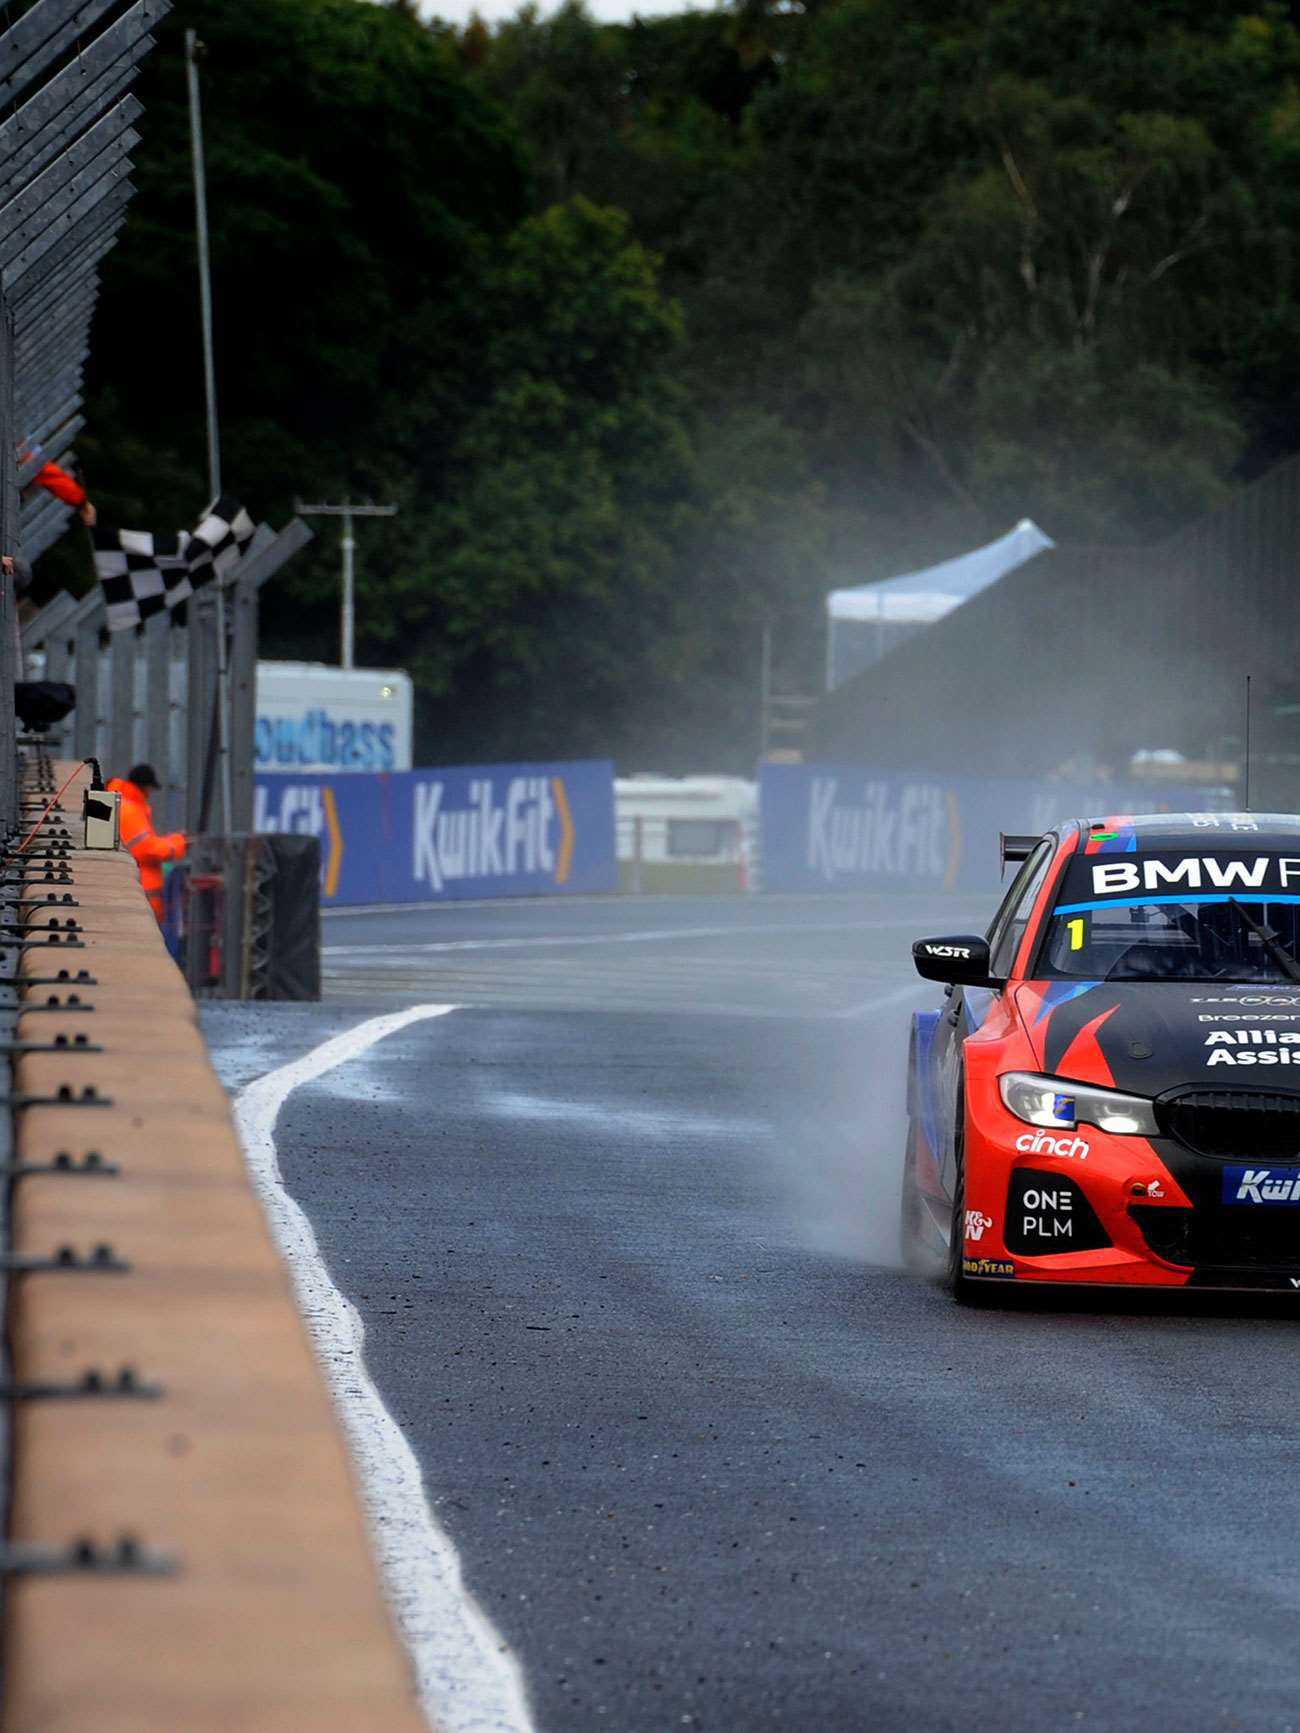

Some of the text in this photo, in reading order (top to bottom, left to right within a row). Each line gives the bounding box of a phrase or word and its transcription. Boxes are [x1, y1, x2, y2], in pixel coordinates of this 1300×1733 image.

[1067, 919, 1084, 951] 1
[925, 944, 970, 959] WSR
[1016, 1129, 1090, 1160] cinch
[1023, 1189, 1073, 1210] ONE
[1023, 1216, 1073, 1237] PLM
